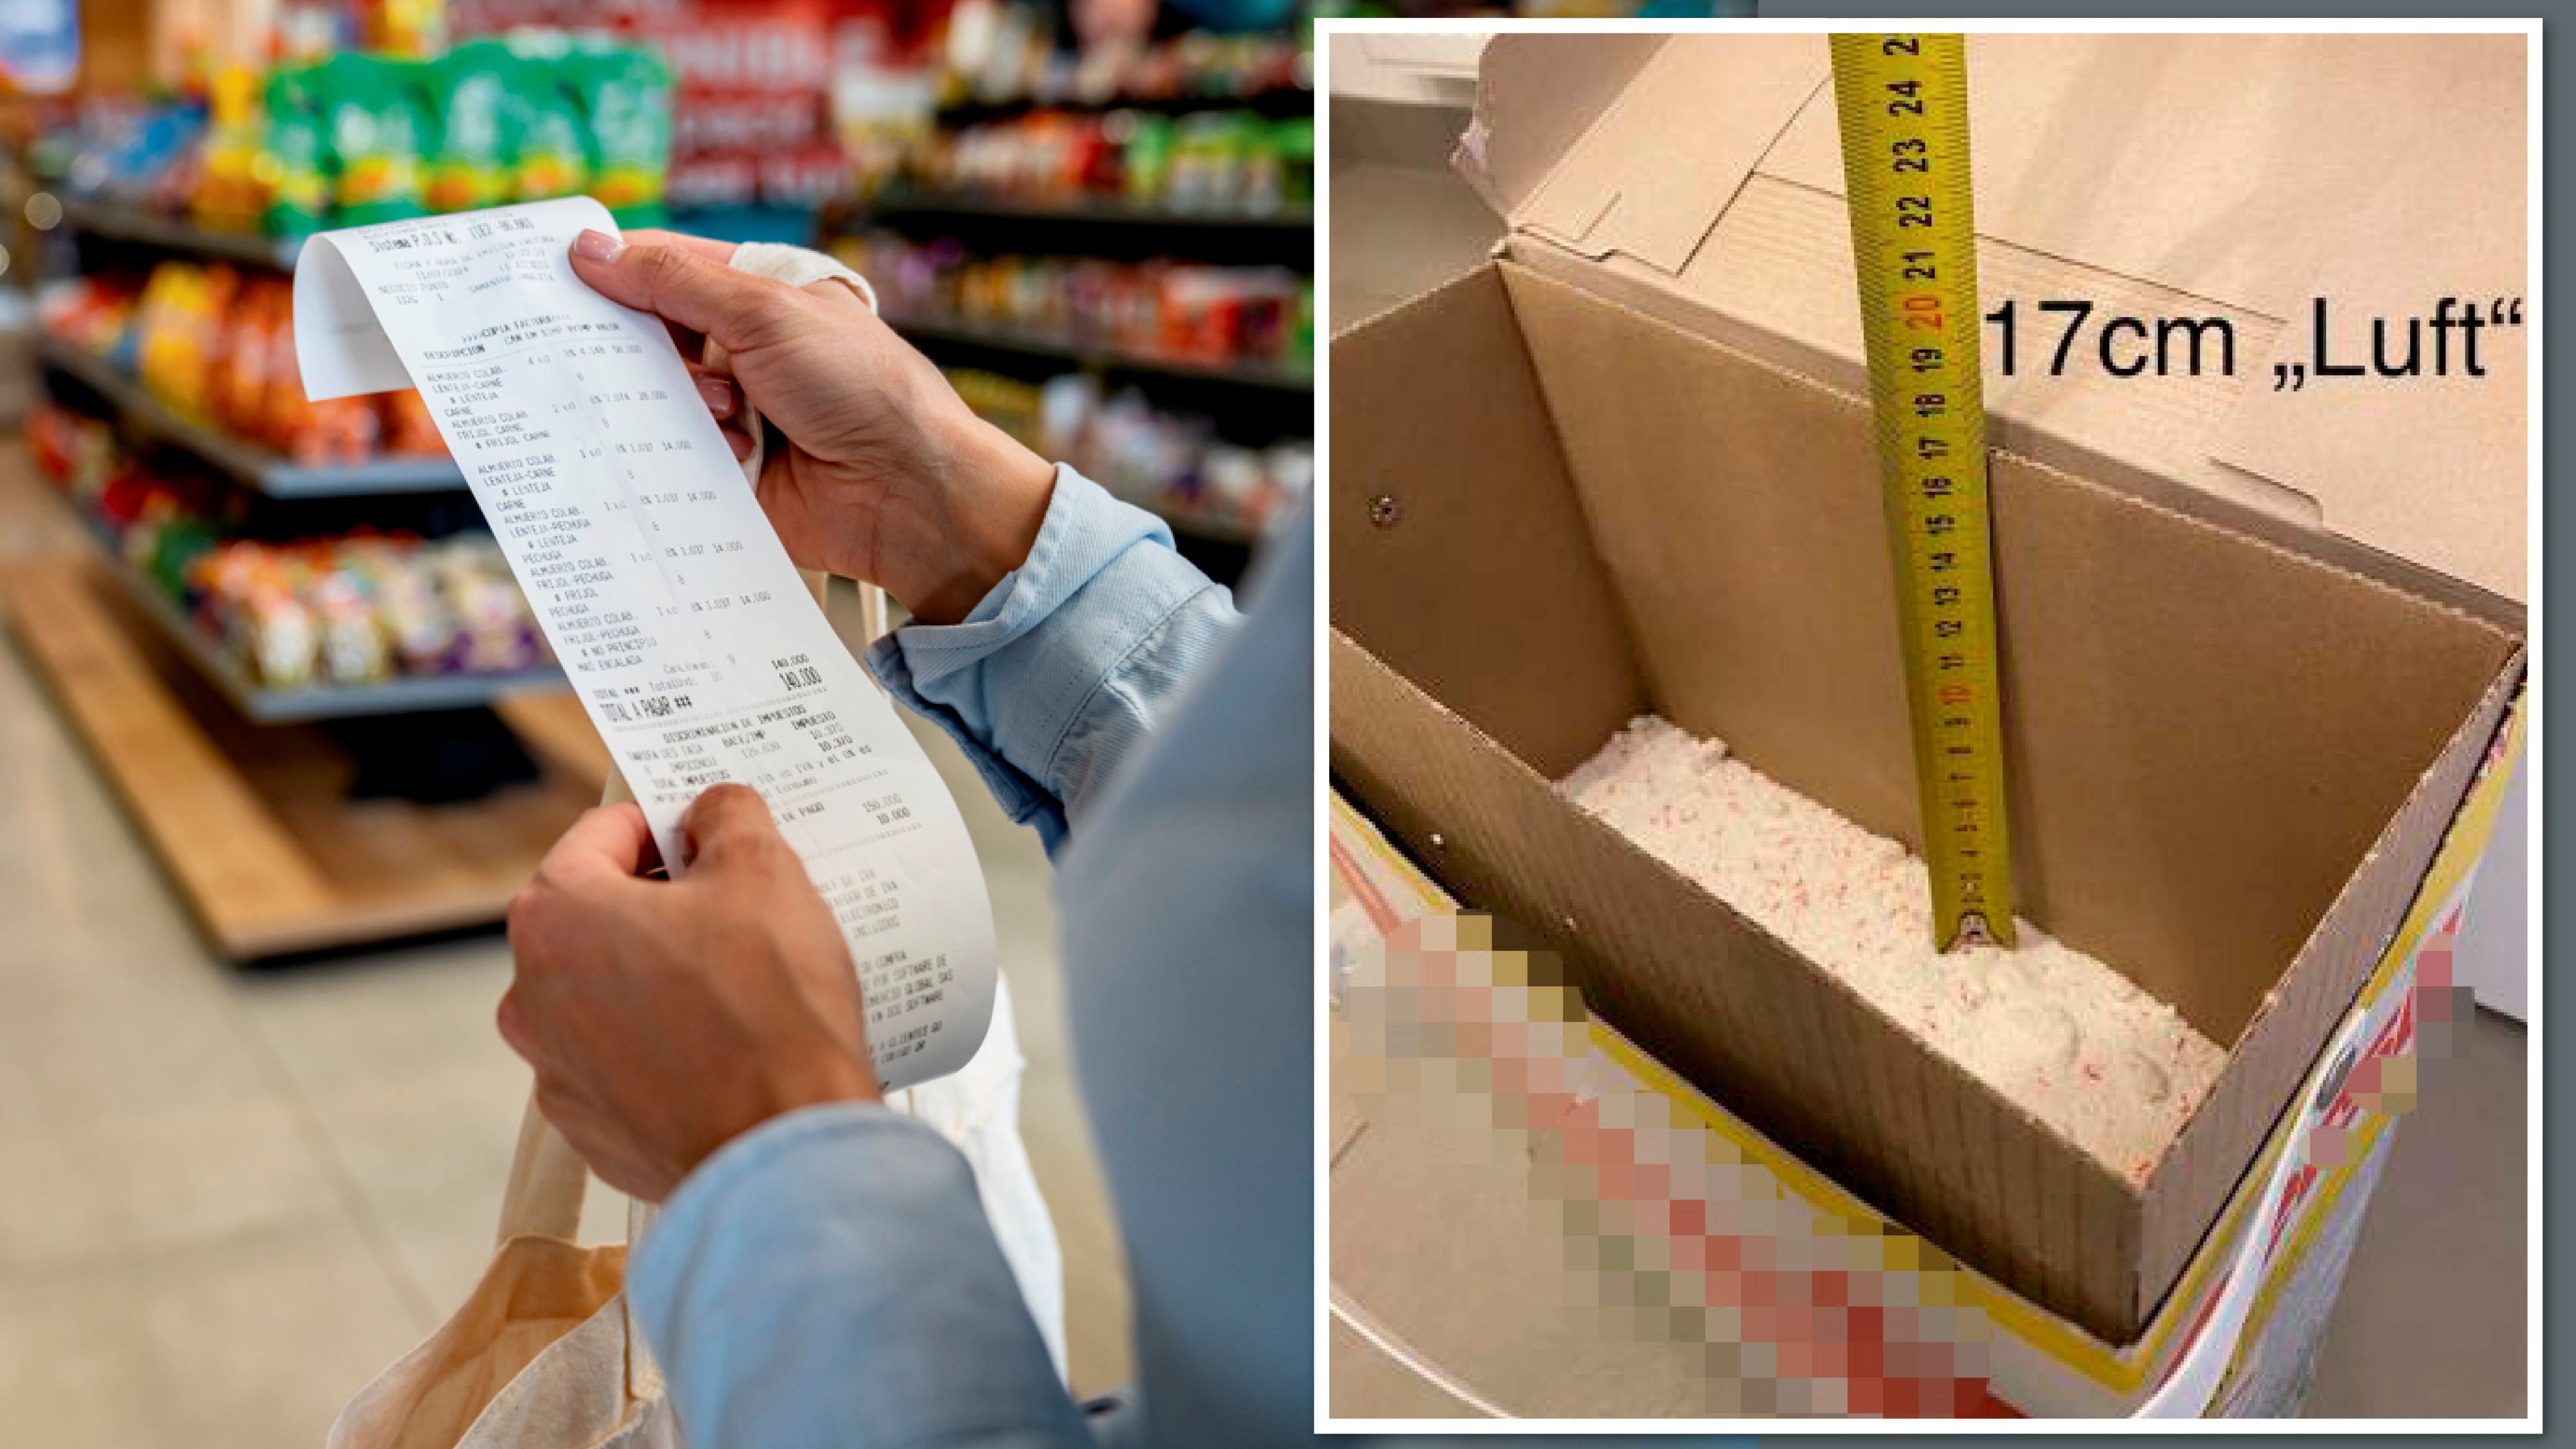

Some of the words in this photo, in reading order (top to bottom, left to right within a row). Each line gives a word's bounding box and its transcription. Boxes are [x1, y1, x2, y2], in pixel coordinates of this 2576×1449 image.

[1886, 80, 1922, 117] 24
[1893, 139, 1928, 172] 23
[1896, 197, 1931, 227] 22
[1902, 250, 1935, 281] 21
[1905, 297, 1942, 330] 20
[1909, 348, 1942, 372] 19
[1915, 394, 1945, 417] 18
[1918, 437, 1950, 459] 17
[1922, 476, 1952, 498] 16
[496, 498, 526, 511] CARNE
[1925, 515, 1955, 536] 15
[537, 534, 578, 549] LENTEJA
[756, 704, 808, 724] IMPUESTOS
[790, 711, 836, 731] IMPUESTO
[881, 880, 898, 894] IVA
[893, 959, 933, 981] SOFTWARE
[905, 989, 943, 1012] SOFTWARE
